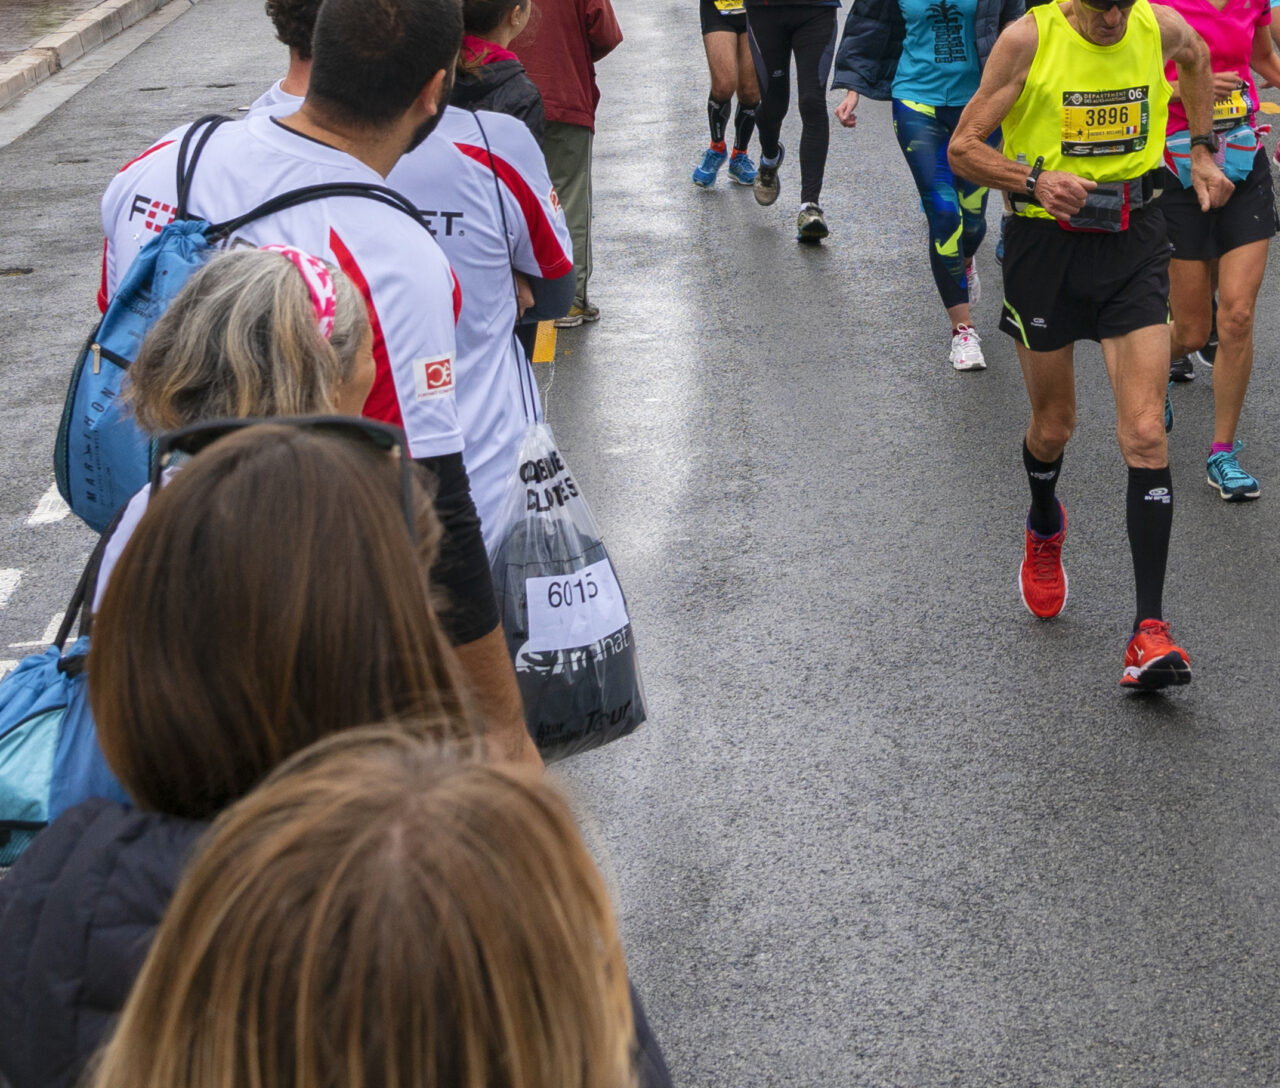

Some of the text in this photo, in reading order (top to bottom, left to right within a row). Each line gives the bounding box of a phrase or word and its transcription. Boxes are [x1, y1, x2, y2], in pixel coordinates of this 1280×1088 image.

[1128, 89, 1143, 100] 06
[1085, 106, 1129, 127] 3896
[548, 573, 598, 608] 6015
